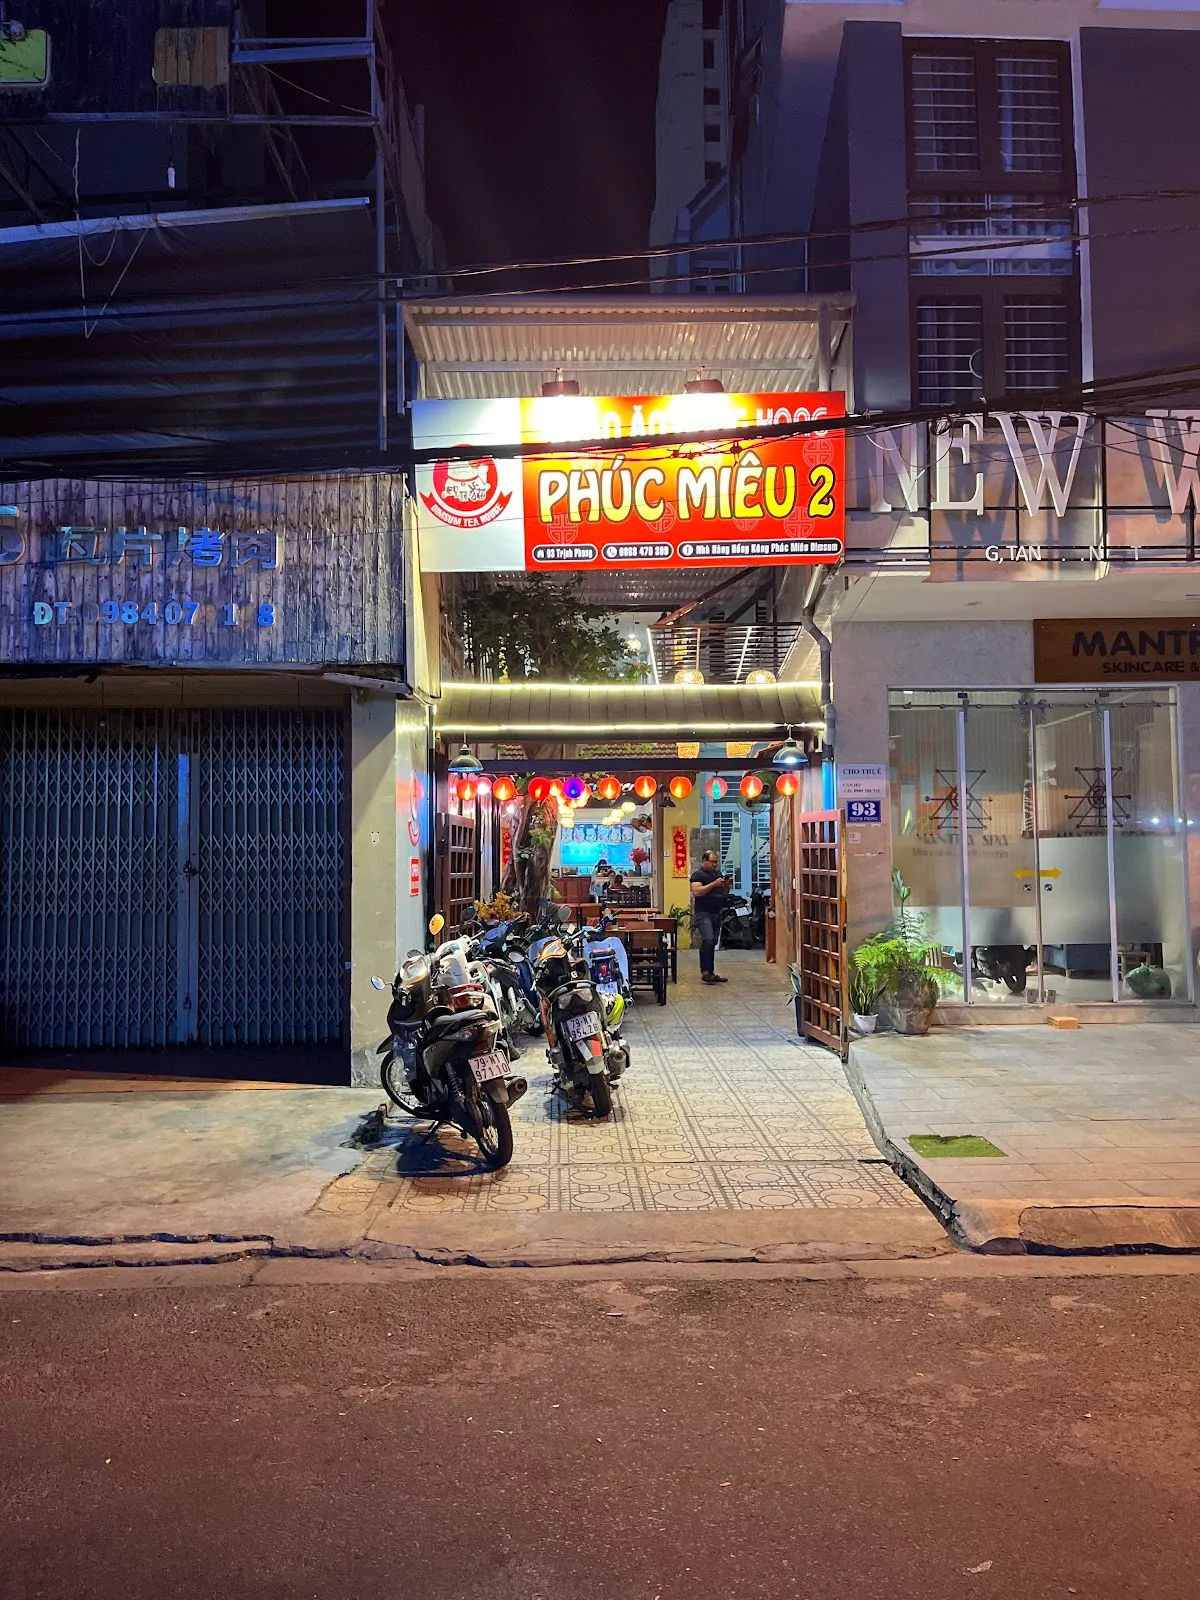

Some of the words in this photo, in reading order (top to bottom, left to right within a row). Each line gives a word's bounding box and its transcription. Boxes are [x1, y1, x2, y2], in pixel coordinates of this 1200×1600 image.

[868, 408, 1097, 518] NEW
[539, 454, 665, 523] PHÚC
[808, 465, 835, 518] 2
[430, 503, 462, 527] DIMSUM
[463, 518, 480, 528] TEA
[480, 503, 504, 525] HOUSE
[546, 548, 556, 559] 93
[1102, 660, 1185, 674] SKINCARE
[851, 802, 877, 817] 93
[475, 1062, 508, 1080] 971.10
